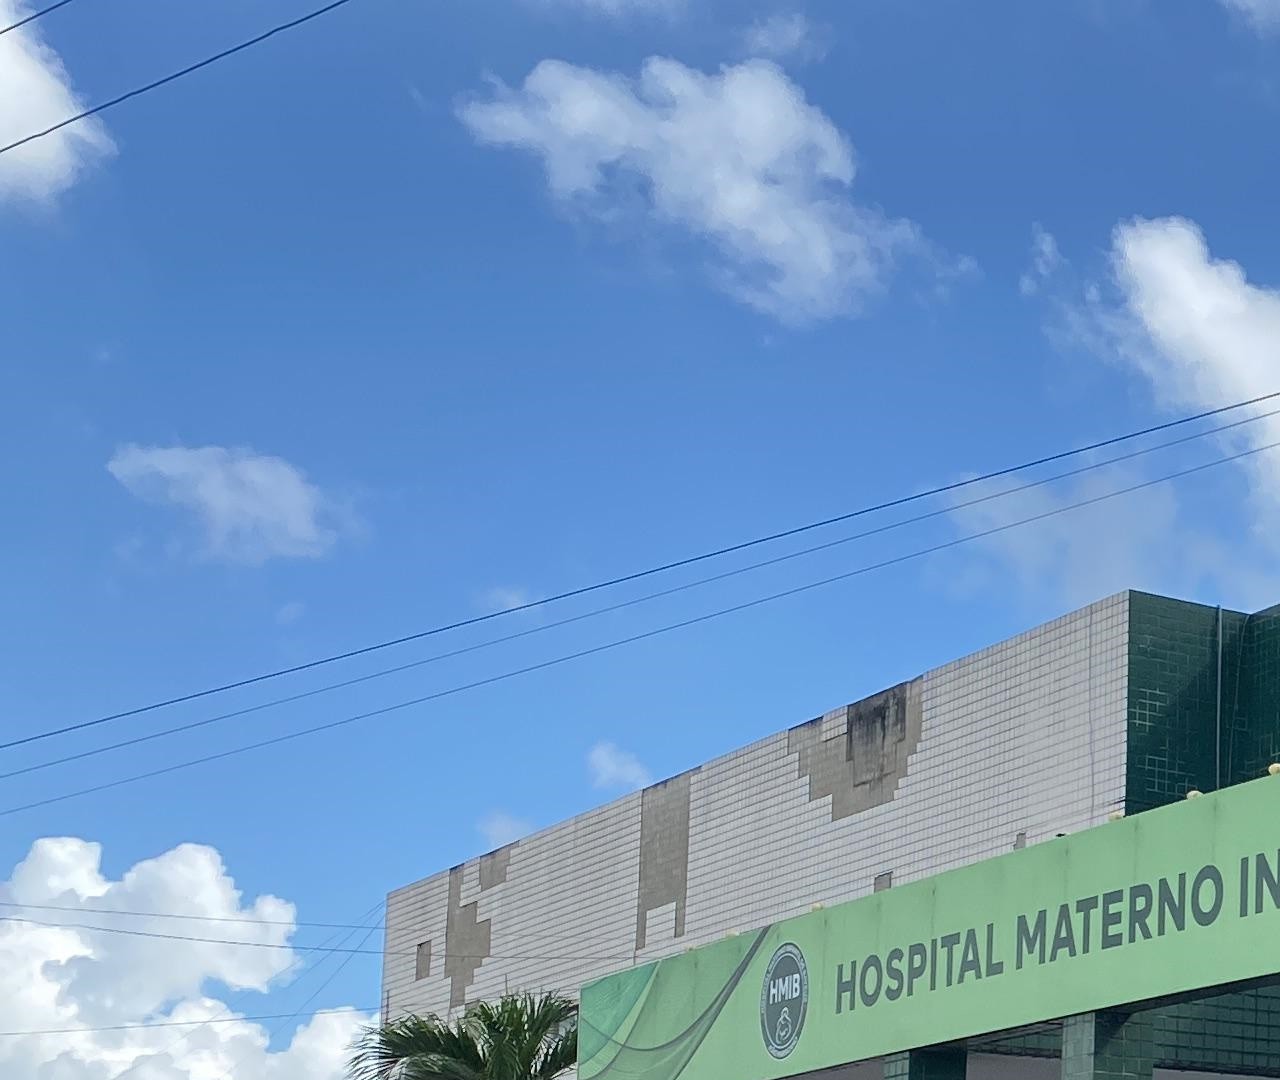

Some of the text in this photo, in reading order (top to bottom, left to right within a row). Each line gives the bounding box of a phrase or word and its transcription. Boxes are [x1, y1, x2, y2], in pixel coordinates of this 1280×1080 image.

[834, 922, 1005, 1015] HOSPITAL
[1014, 863, 1224, 969] MATERNO
[769, 972, 801, 1005] HMIB
